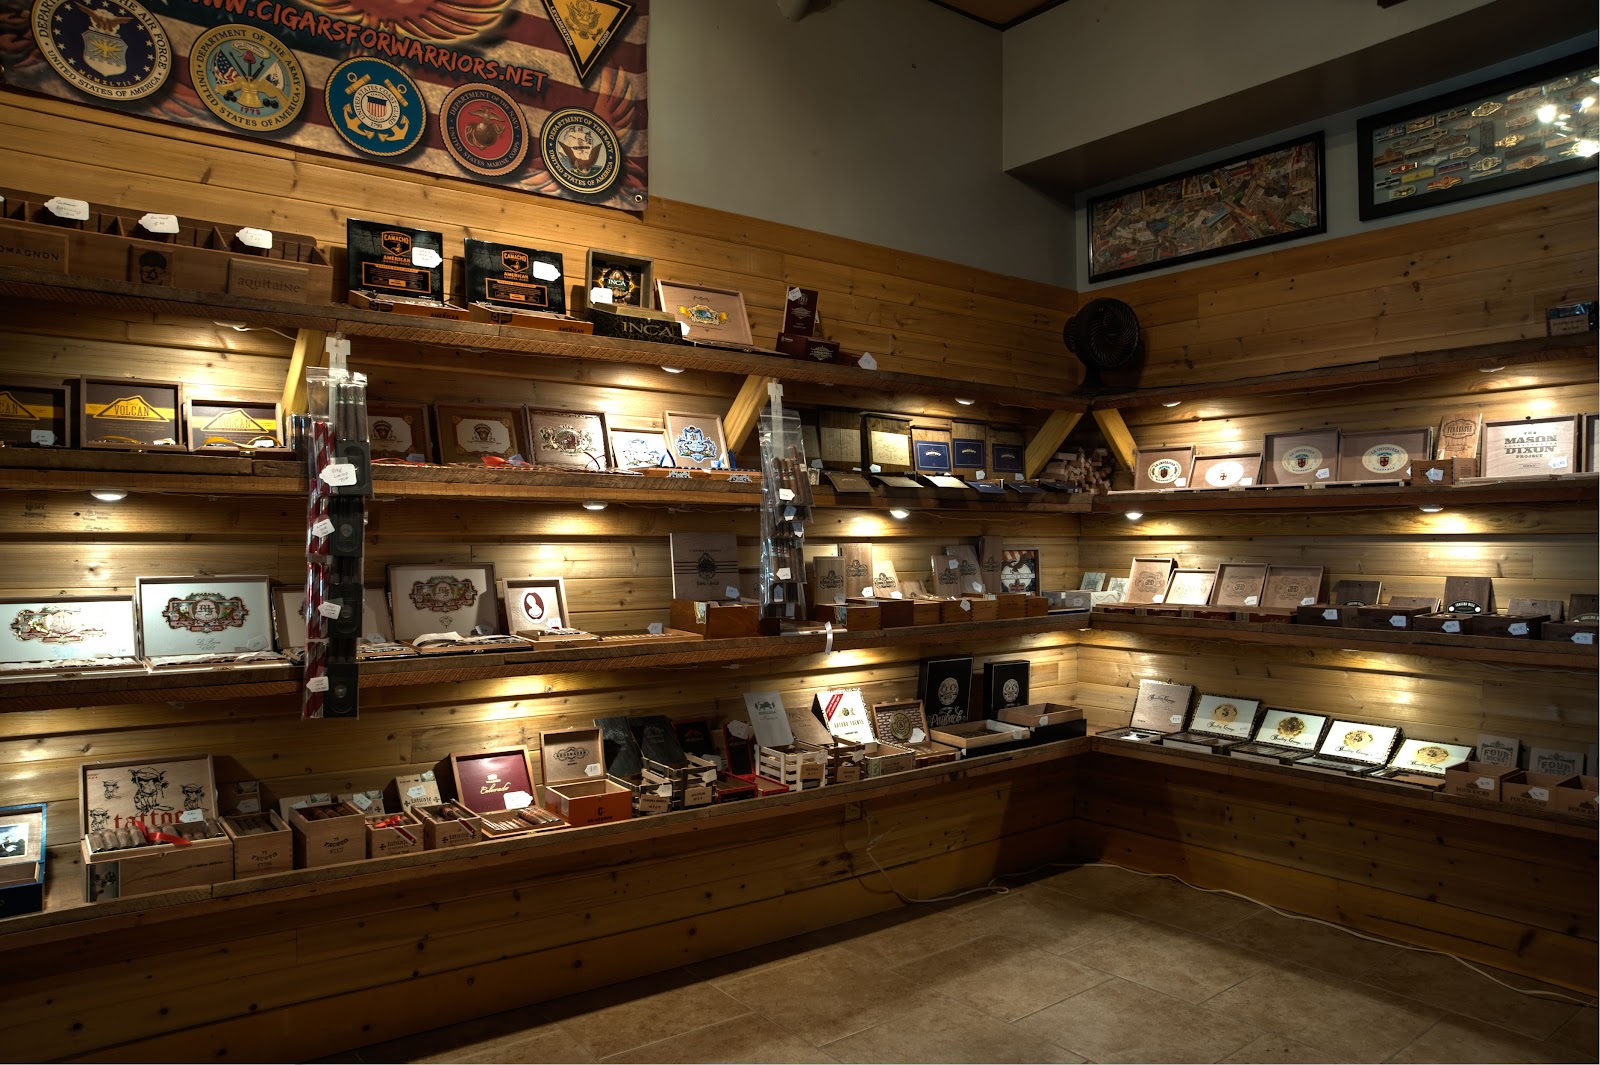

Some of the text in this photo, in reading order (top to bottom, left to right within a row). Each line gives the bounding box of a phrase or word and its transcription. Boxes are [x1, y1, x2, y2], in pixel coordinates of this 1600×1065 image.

[138, 11, 157, 30] AIR
[154, 32, 168, 70] FORCE
[191, 0, 548, 92] WW.CIGARSFORWARRIORS.NET
[197, 29, 301, 88] DEPARTMENT OF THE ARMY
[47, 50, 77, 81] UNITED
[78, 79, 113, 96] STATES
[130, 76, 161, 96] AMERICA
[196, 70, 301, 128] UNITED STATES OF AMERICA
[360, 85, 377, 97] STATES
[379, 87, 396, 104] COAST
[355, 96, 366, 120] UNITED
[450, 91, 490, 116] DEPARTMENT
[500, 100, 510, 110] THE
[509, 111, 520, 130] NAVY
[549, 116, 614, 153] DEPARTMENT OF THE NAVY
[449, 127, 520, 167] UNITED STATES MARINE CORPS
[549, 150, 564, 173] UNITED
[563, 172, 586, 186] STATES
[596, 161, 613, 184] AMERICA
[384, 234, 409, 244] CAMACHO
[383, 255, 411, 263] AMERICAN
[504, 253, 526, 261] CAMACHO
[608, 279, 627, 287] INCA
[622, 322, 674, 337] INCA
[113, 405, 150, 417] VOLCAN
[1504, 435, 1558, 444] MASON
[1484, 749, 1510, 758] FOUR
[1541, 761, 1570, 770] FOUR
